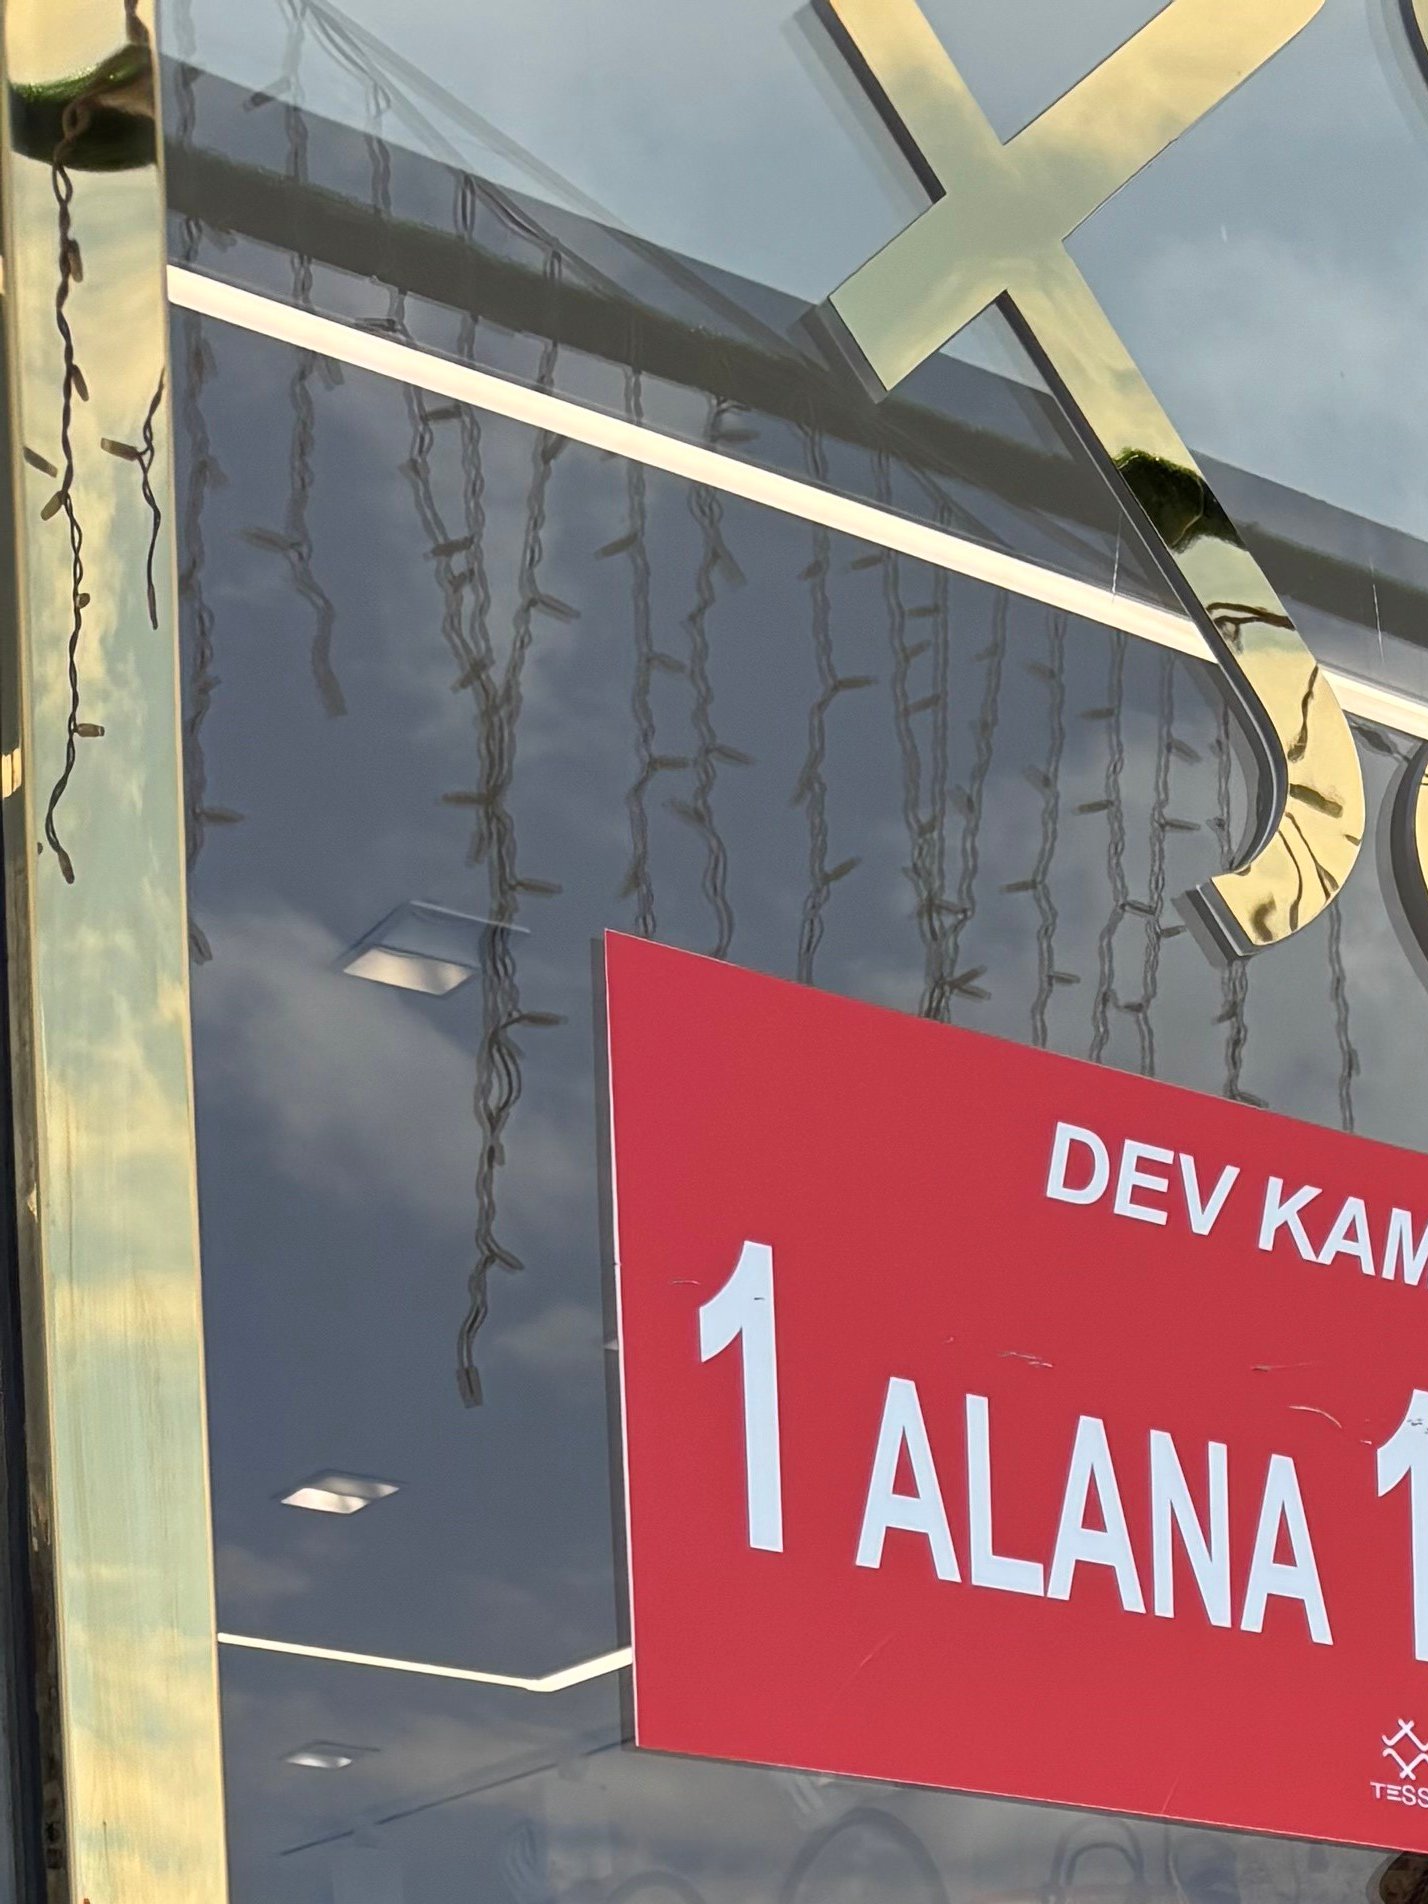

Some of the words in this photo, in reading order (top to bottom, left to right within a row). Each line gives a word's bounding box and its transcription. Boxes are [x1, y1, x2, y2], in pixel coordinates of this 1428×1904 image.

[1045, 1120, 1242, 1237] DEV
[697, 1239, 785, 1554] 1
[854, 1375, 1335, 1647] ALANA
